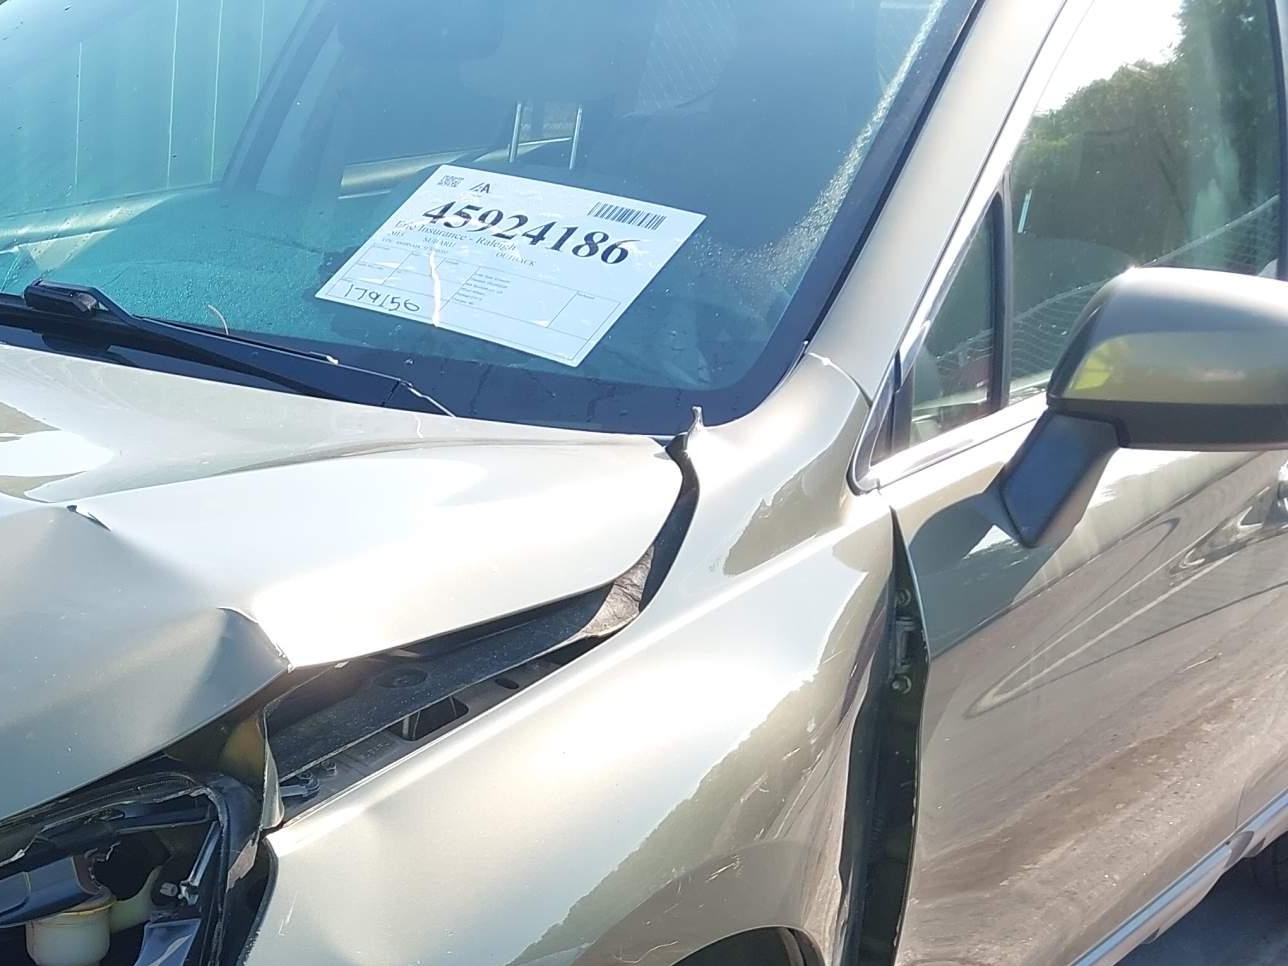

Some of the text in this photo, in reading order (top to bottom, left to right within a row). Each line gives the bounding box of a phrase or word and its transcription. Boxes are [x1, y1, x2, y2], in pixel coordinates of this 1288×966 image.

[416, 223, 469, 241] Insurance
[475, 235, 518, 252] Raleigh
[421, 200, 641, 265] 45924186
